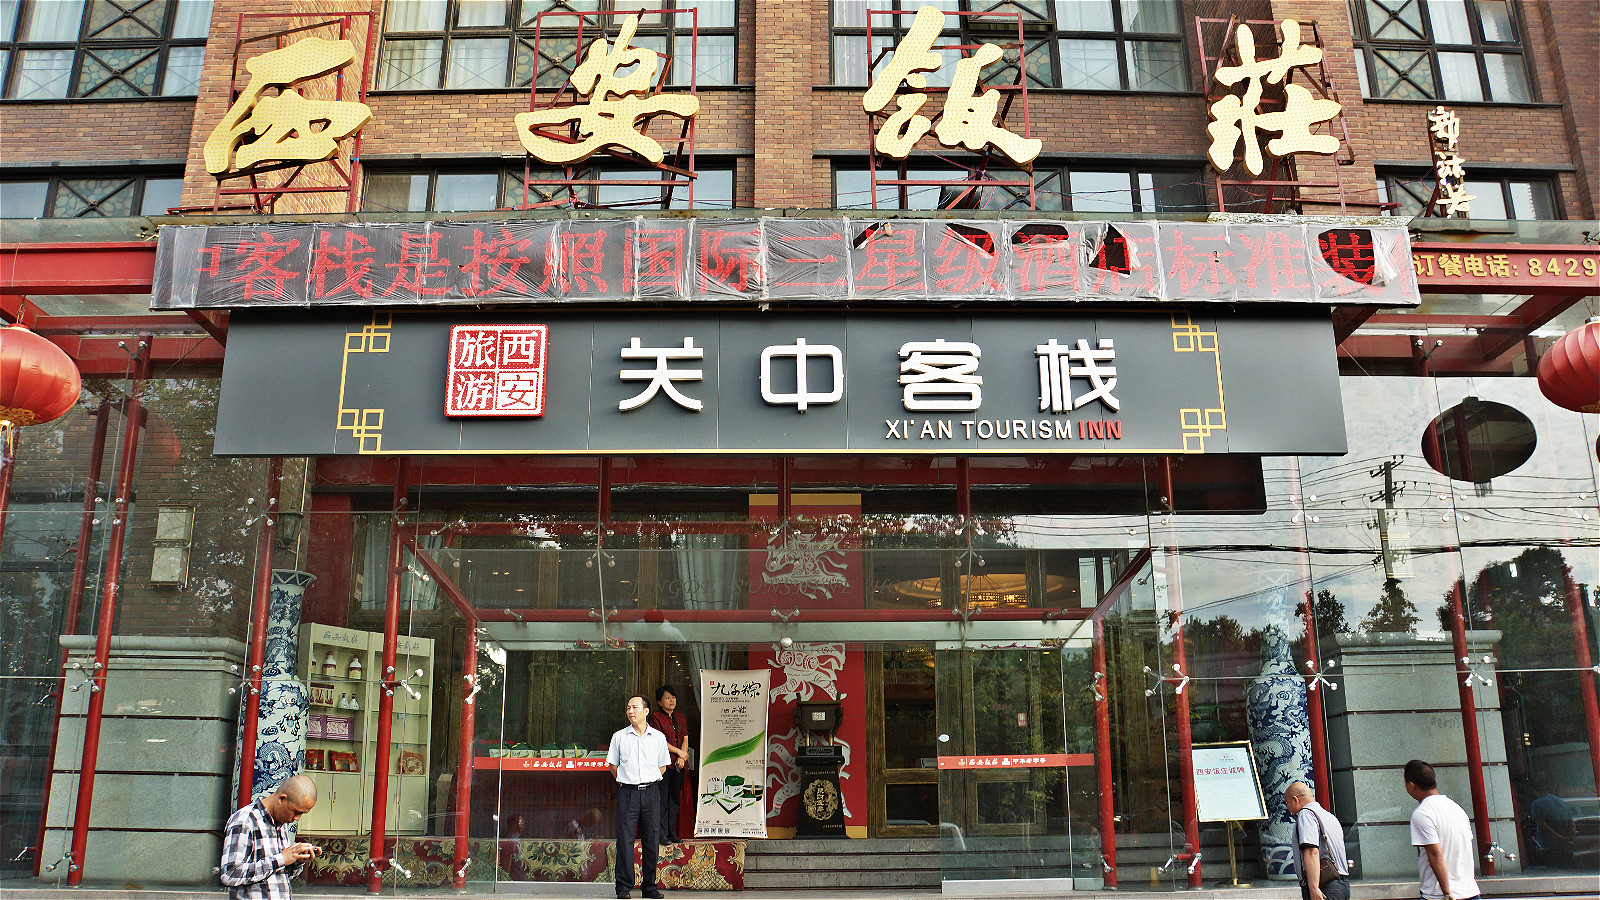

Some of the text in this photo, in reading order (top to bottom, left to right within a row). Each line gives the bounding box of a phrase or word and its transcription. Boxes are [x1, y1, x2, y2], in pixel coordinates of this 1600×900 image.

[618, 336, 1121, 413] 关中客栈
[961, 420, 1073, 440] TOURISM
[1079, 420, 1123, 440] INN
